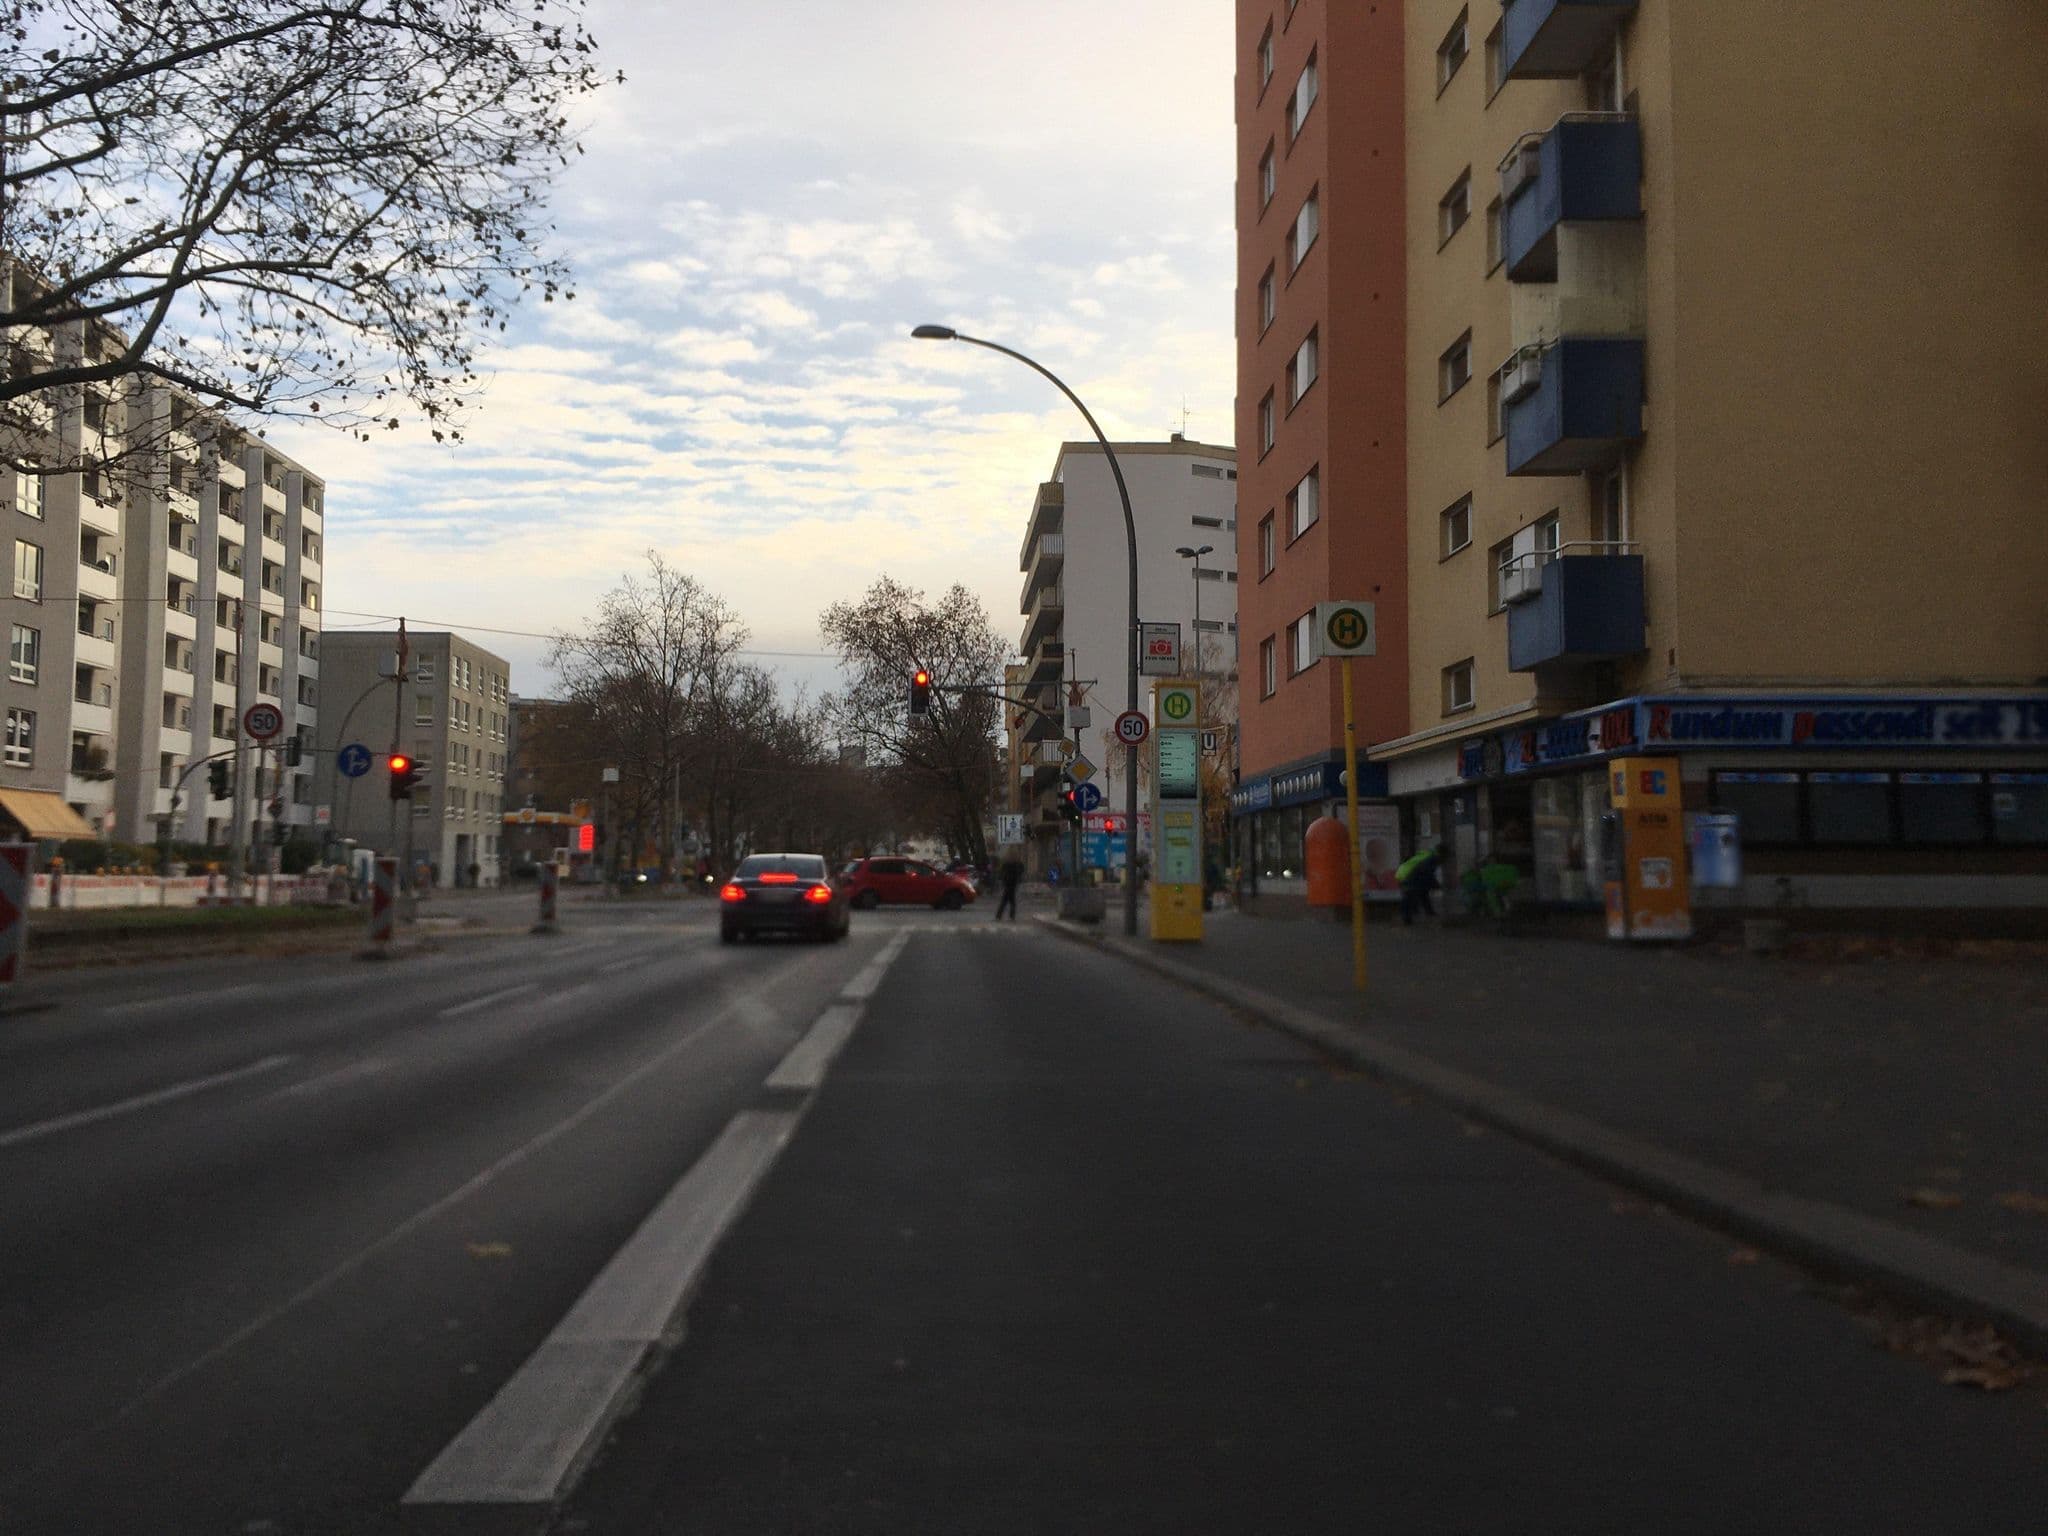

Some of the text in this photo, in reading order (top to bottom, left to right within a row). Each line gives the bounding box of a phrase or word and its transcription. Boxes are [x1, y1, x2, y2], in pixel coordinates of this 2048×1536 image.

[1339, 618, 1357, 639] H
[1172, 698, 1183, 713] H
[254, 713, 275, 730] 50
[1124, 720, 1143, 736] 50
[1203, 733, 1215, 750] U
